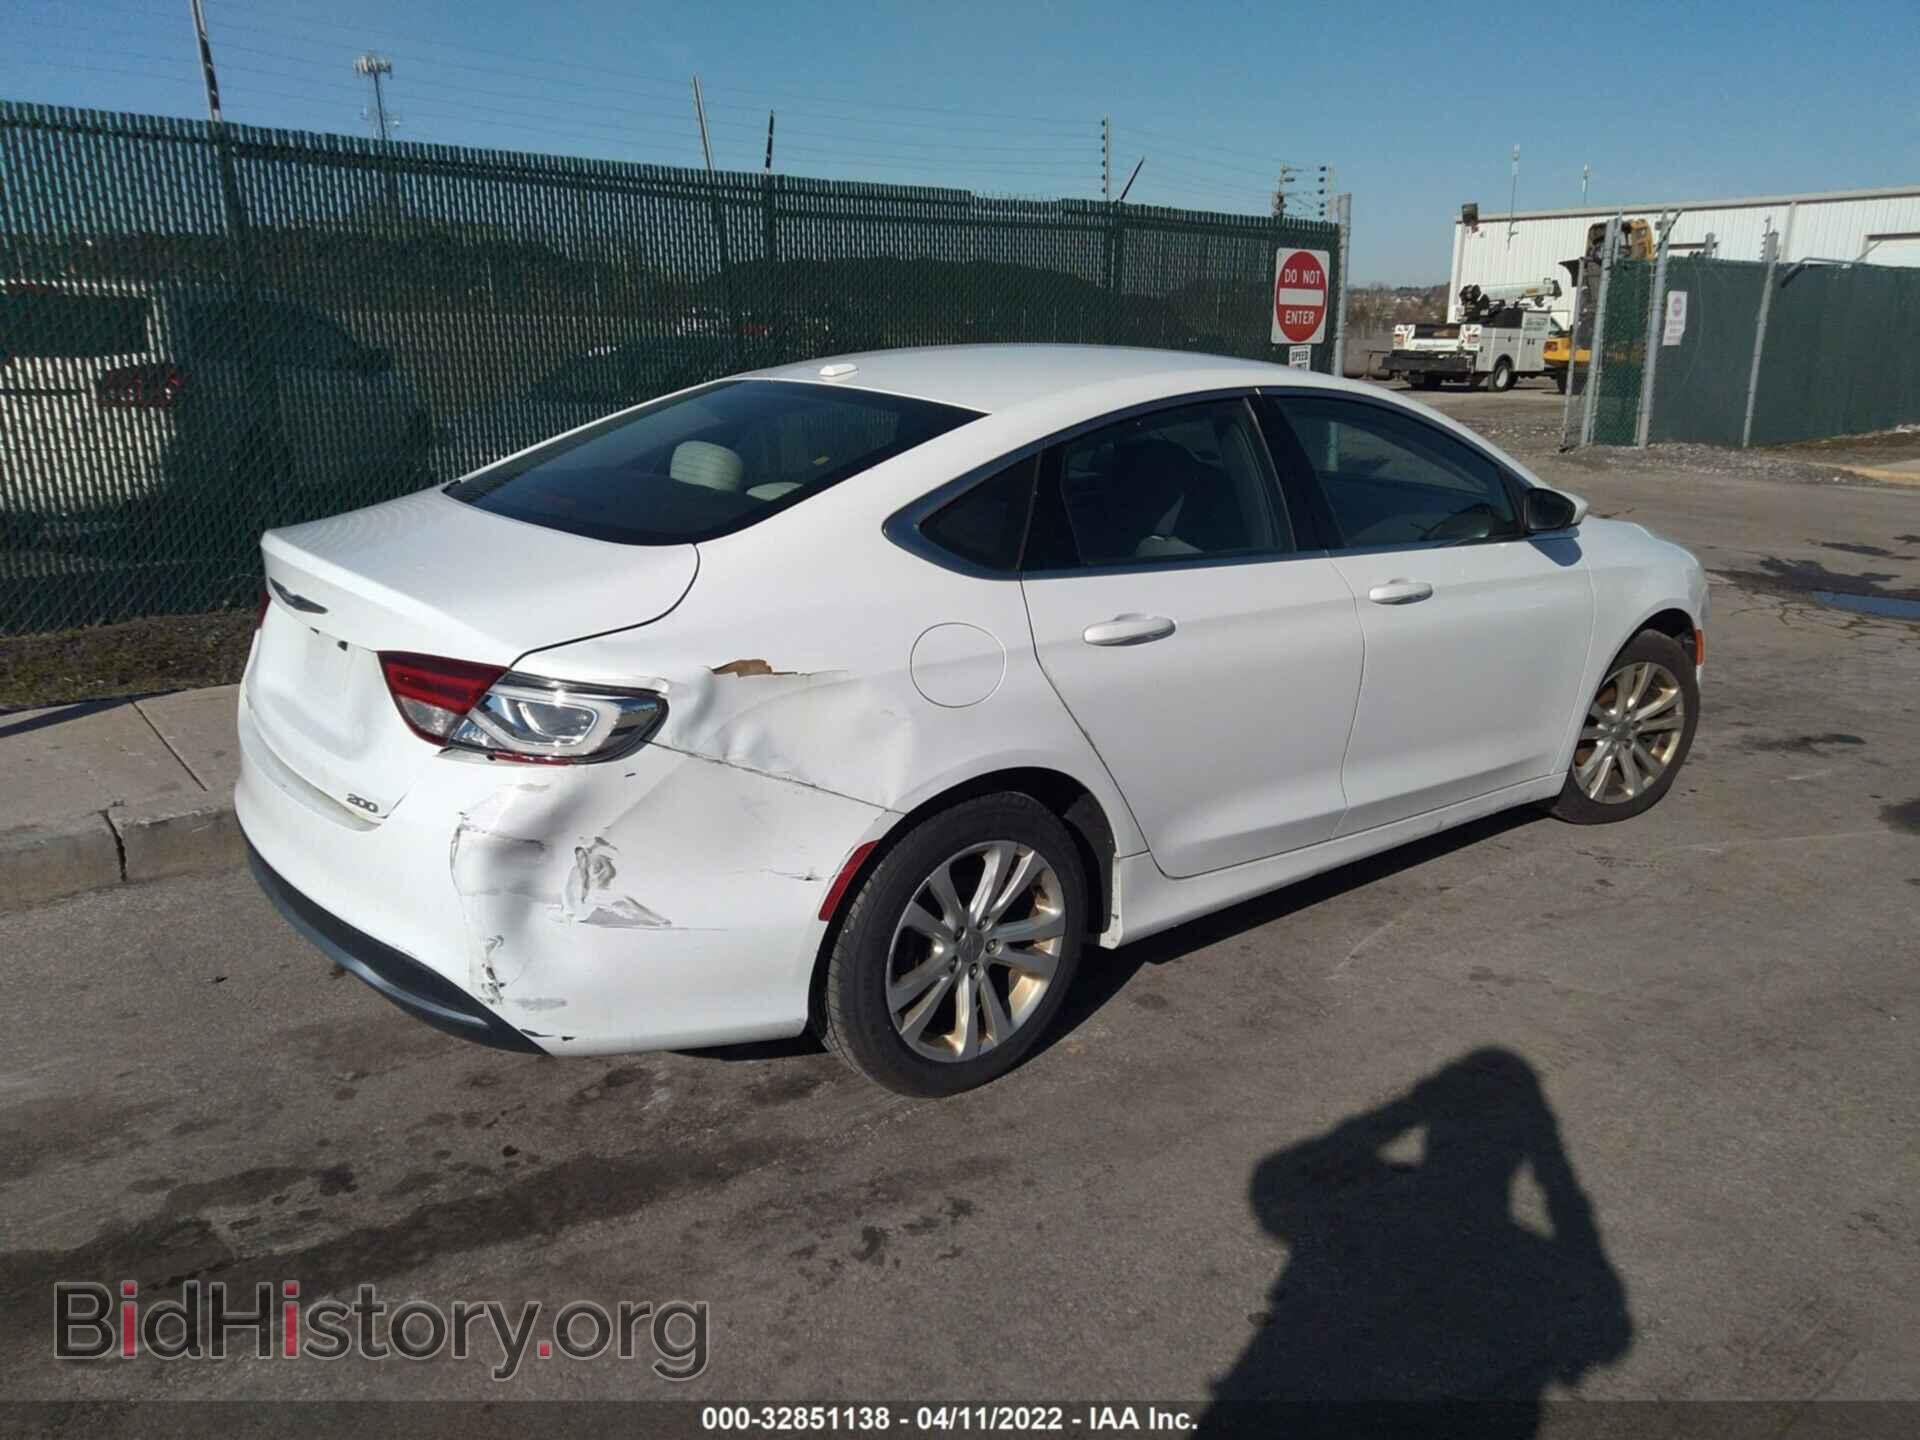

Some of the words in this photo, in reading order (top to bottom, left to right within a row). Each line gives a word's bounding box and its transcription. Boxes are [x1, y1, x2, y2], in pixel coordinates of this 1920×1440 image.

[1284, 268, 1298, 283] DO
[1302, 270, 1321, 285] NOT
[1285, 310, 1315, 325] ENTER
[346, 793, 379, 813] 200
